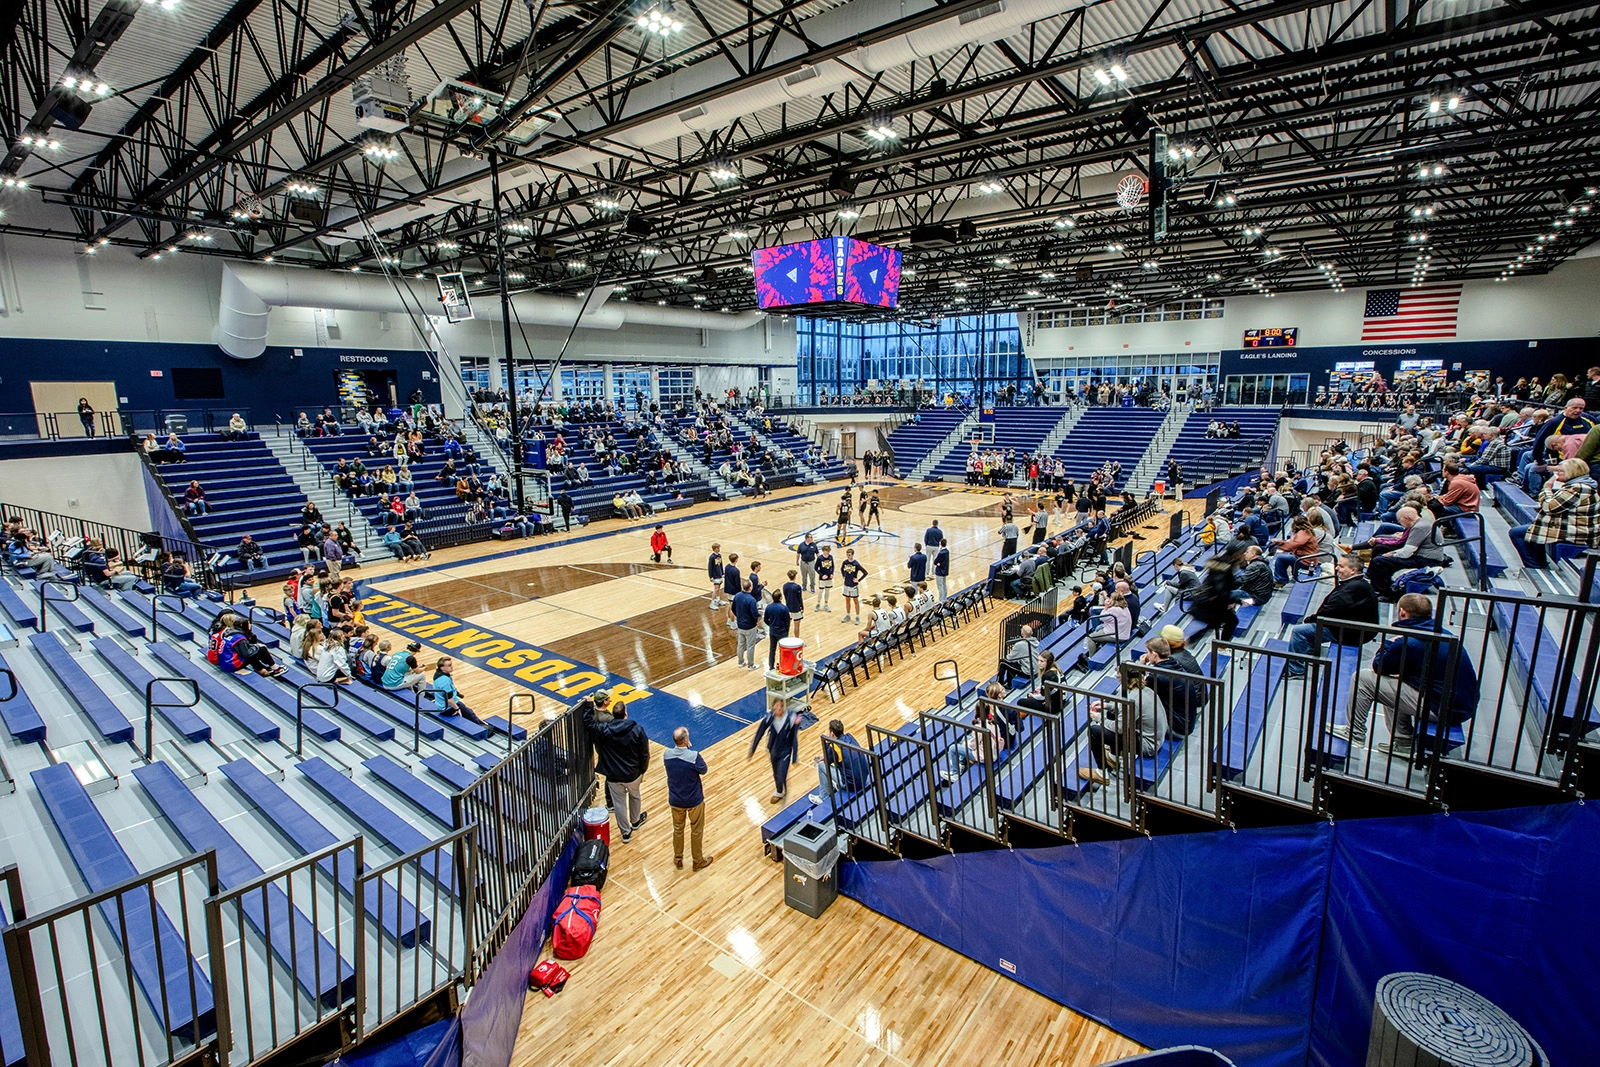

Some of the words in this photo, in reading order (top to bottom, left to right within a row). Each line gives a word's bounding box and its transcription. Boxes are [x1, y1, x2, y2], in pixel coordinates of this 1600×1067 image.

[1264, 328, 1281, 336] 8:00
[1362, 348, 1417, 356] CONCESSIONS
[340, 355, 389, 363] RESTROOMS
